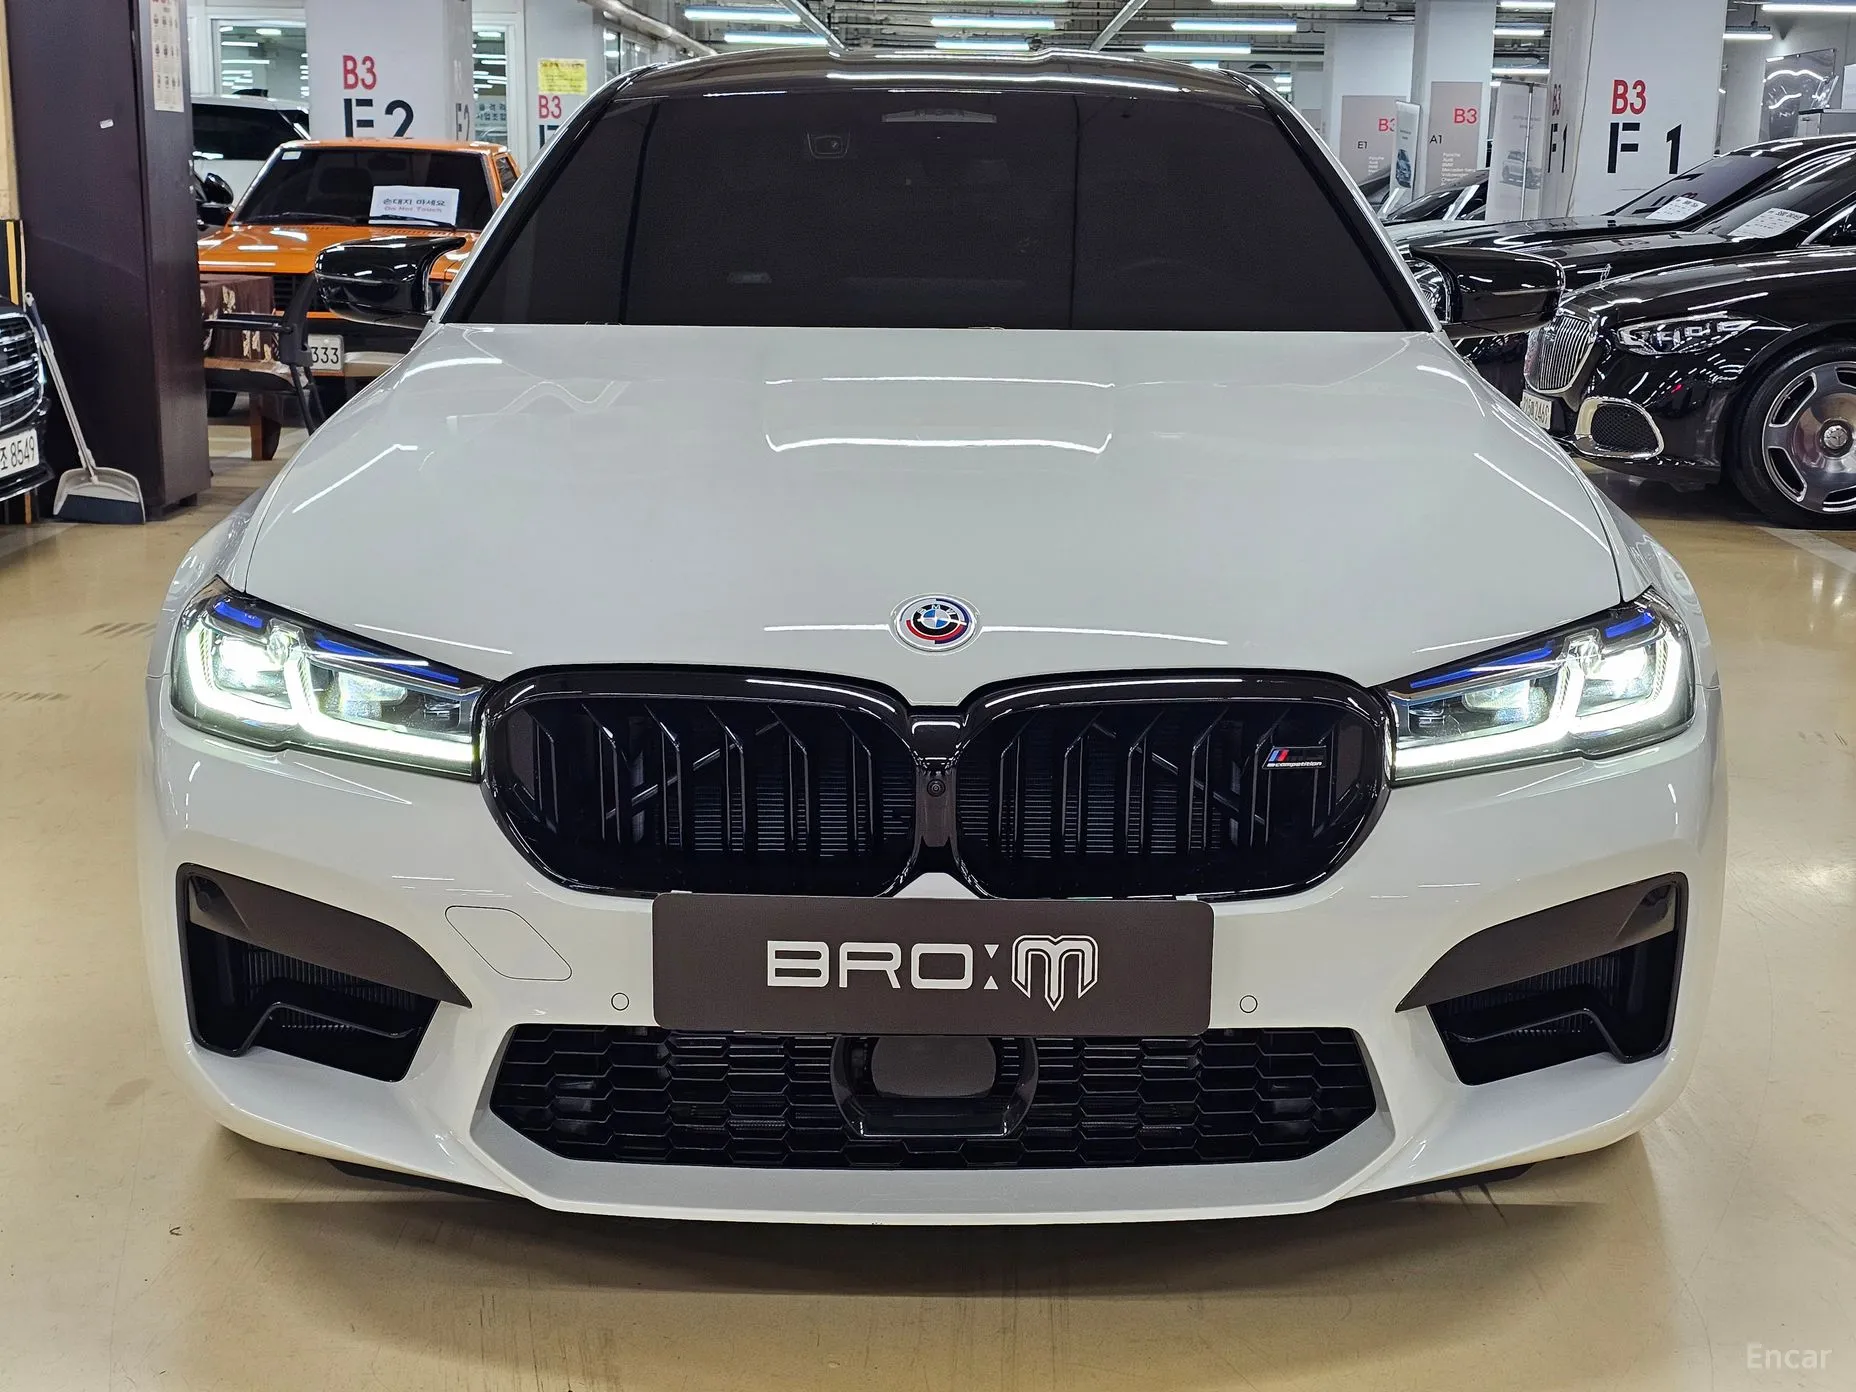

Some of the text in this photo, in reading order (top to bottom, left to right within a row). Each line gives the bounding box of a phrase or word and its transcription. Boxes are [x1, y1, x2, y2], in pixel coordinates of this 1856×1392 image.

[342, 55, 377, 90] B3
[538, 94, 562, 119] B3
[1551, 84, 1562, 116] B3
[1611, 79, 1646, 114] B3
[1453, 108, 1478, 124] B3
[1357, 140, 1368, 149] E1
[1429, 134, 1443, 144] A1
[383, 198, 413, 206] 손대지
[10, 435, 35, 468] 8549
[917, 604, 957, 616] BMW
